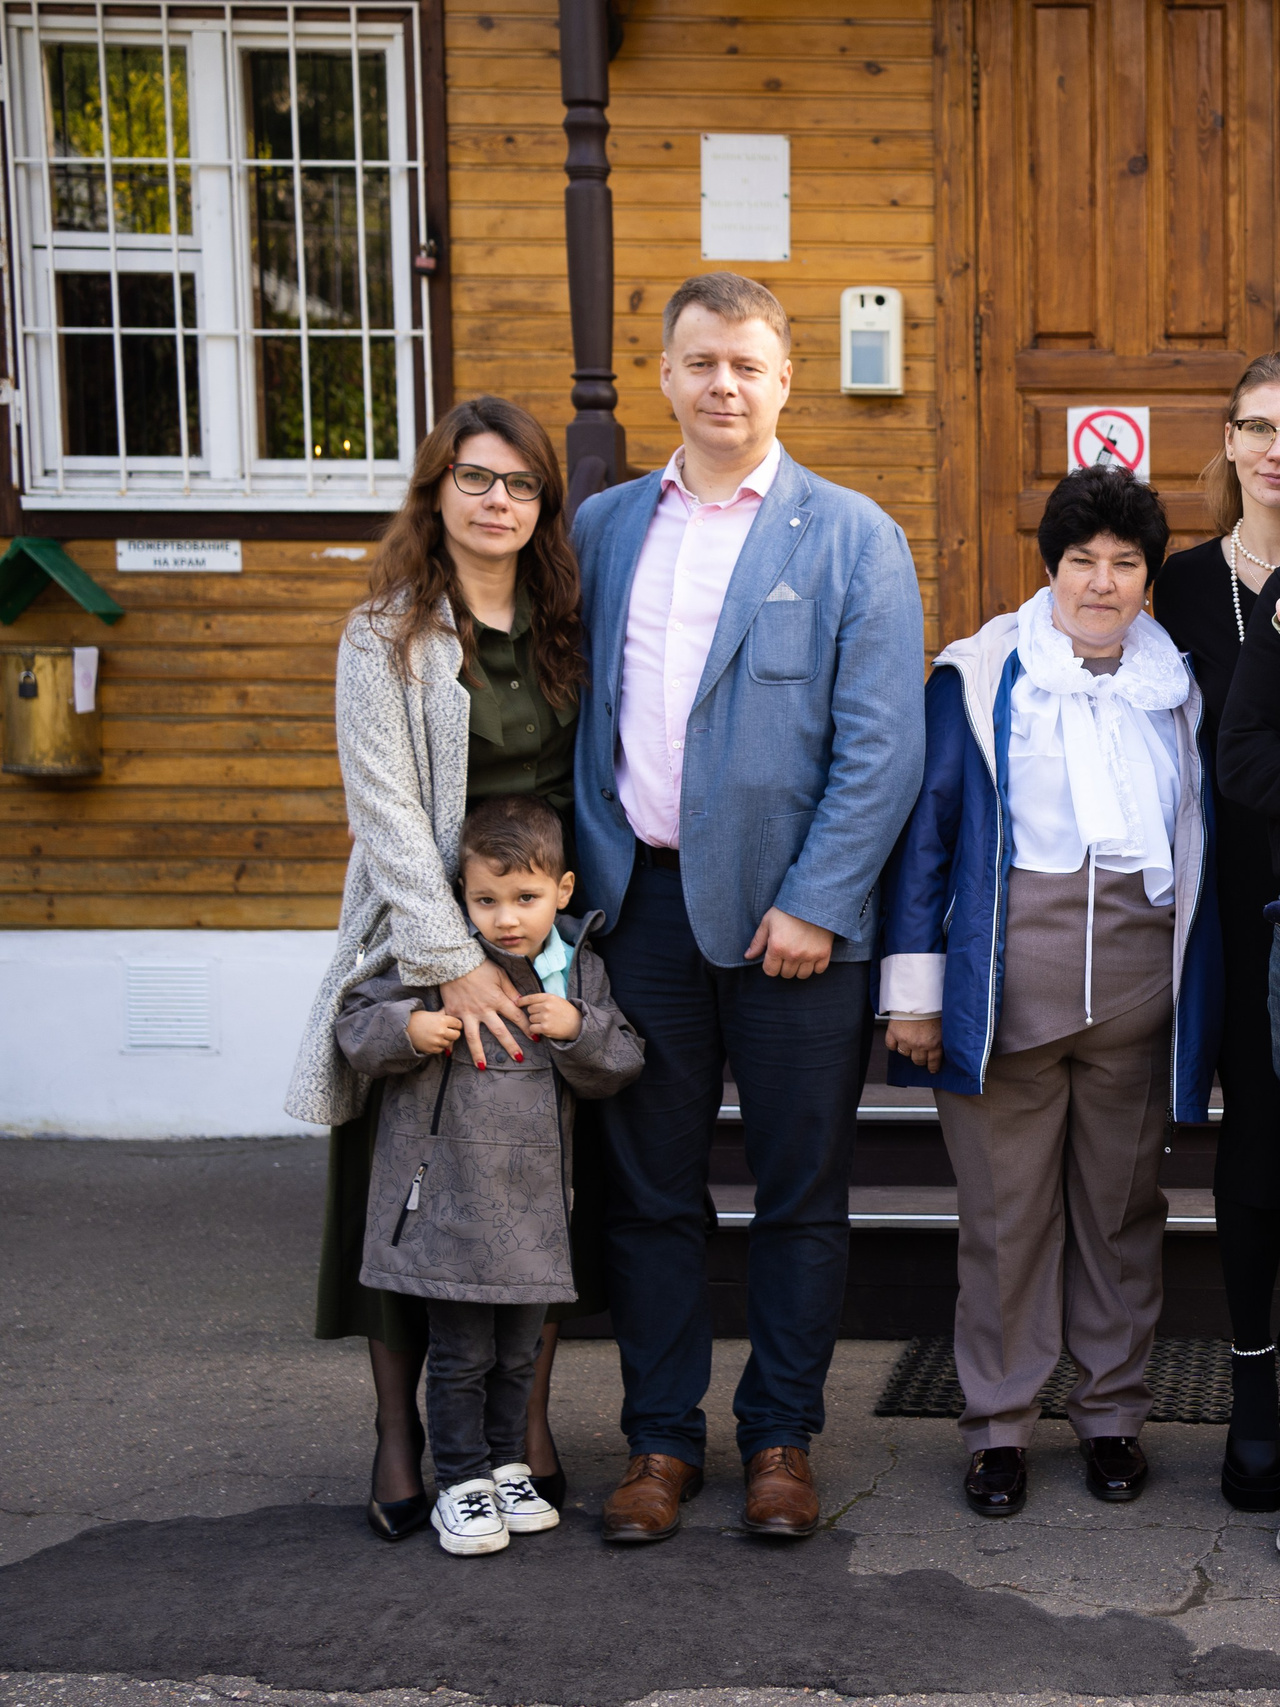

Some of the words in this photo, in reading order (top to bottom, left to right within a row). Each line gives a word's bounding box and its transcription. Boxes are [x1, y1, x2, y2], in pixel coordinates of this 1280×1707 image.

[128, 540, 231, 551] ПОЖЕРТВОВАНИЕ
[153, 557, 170, 567] НА
[173, 557, 207, 567] ХРАМ
